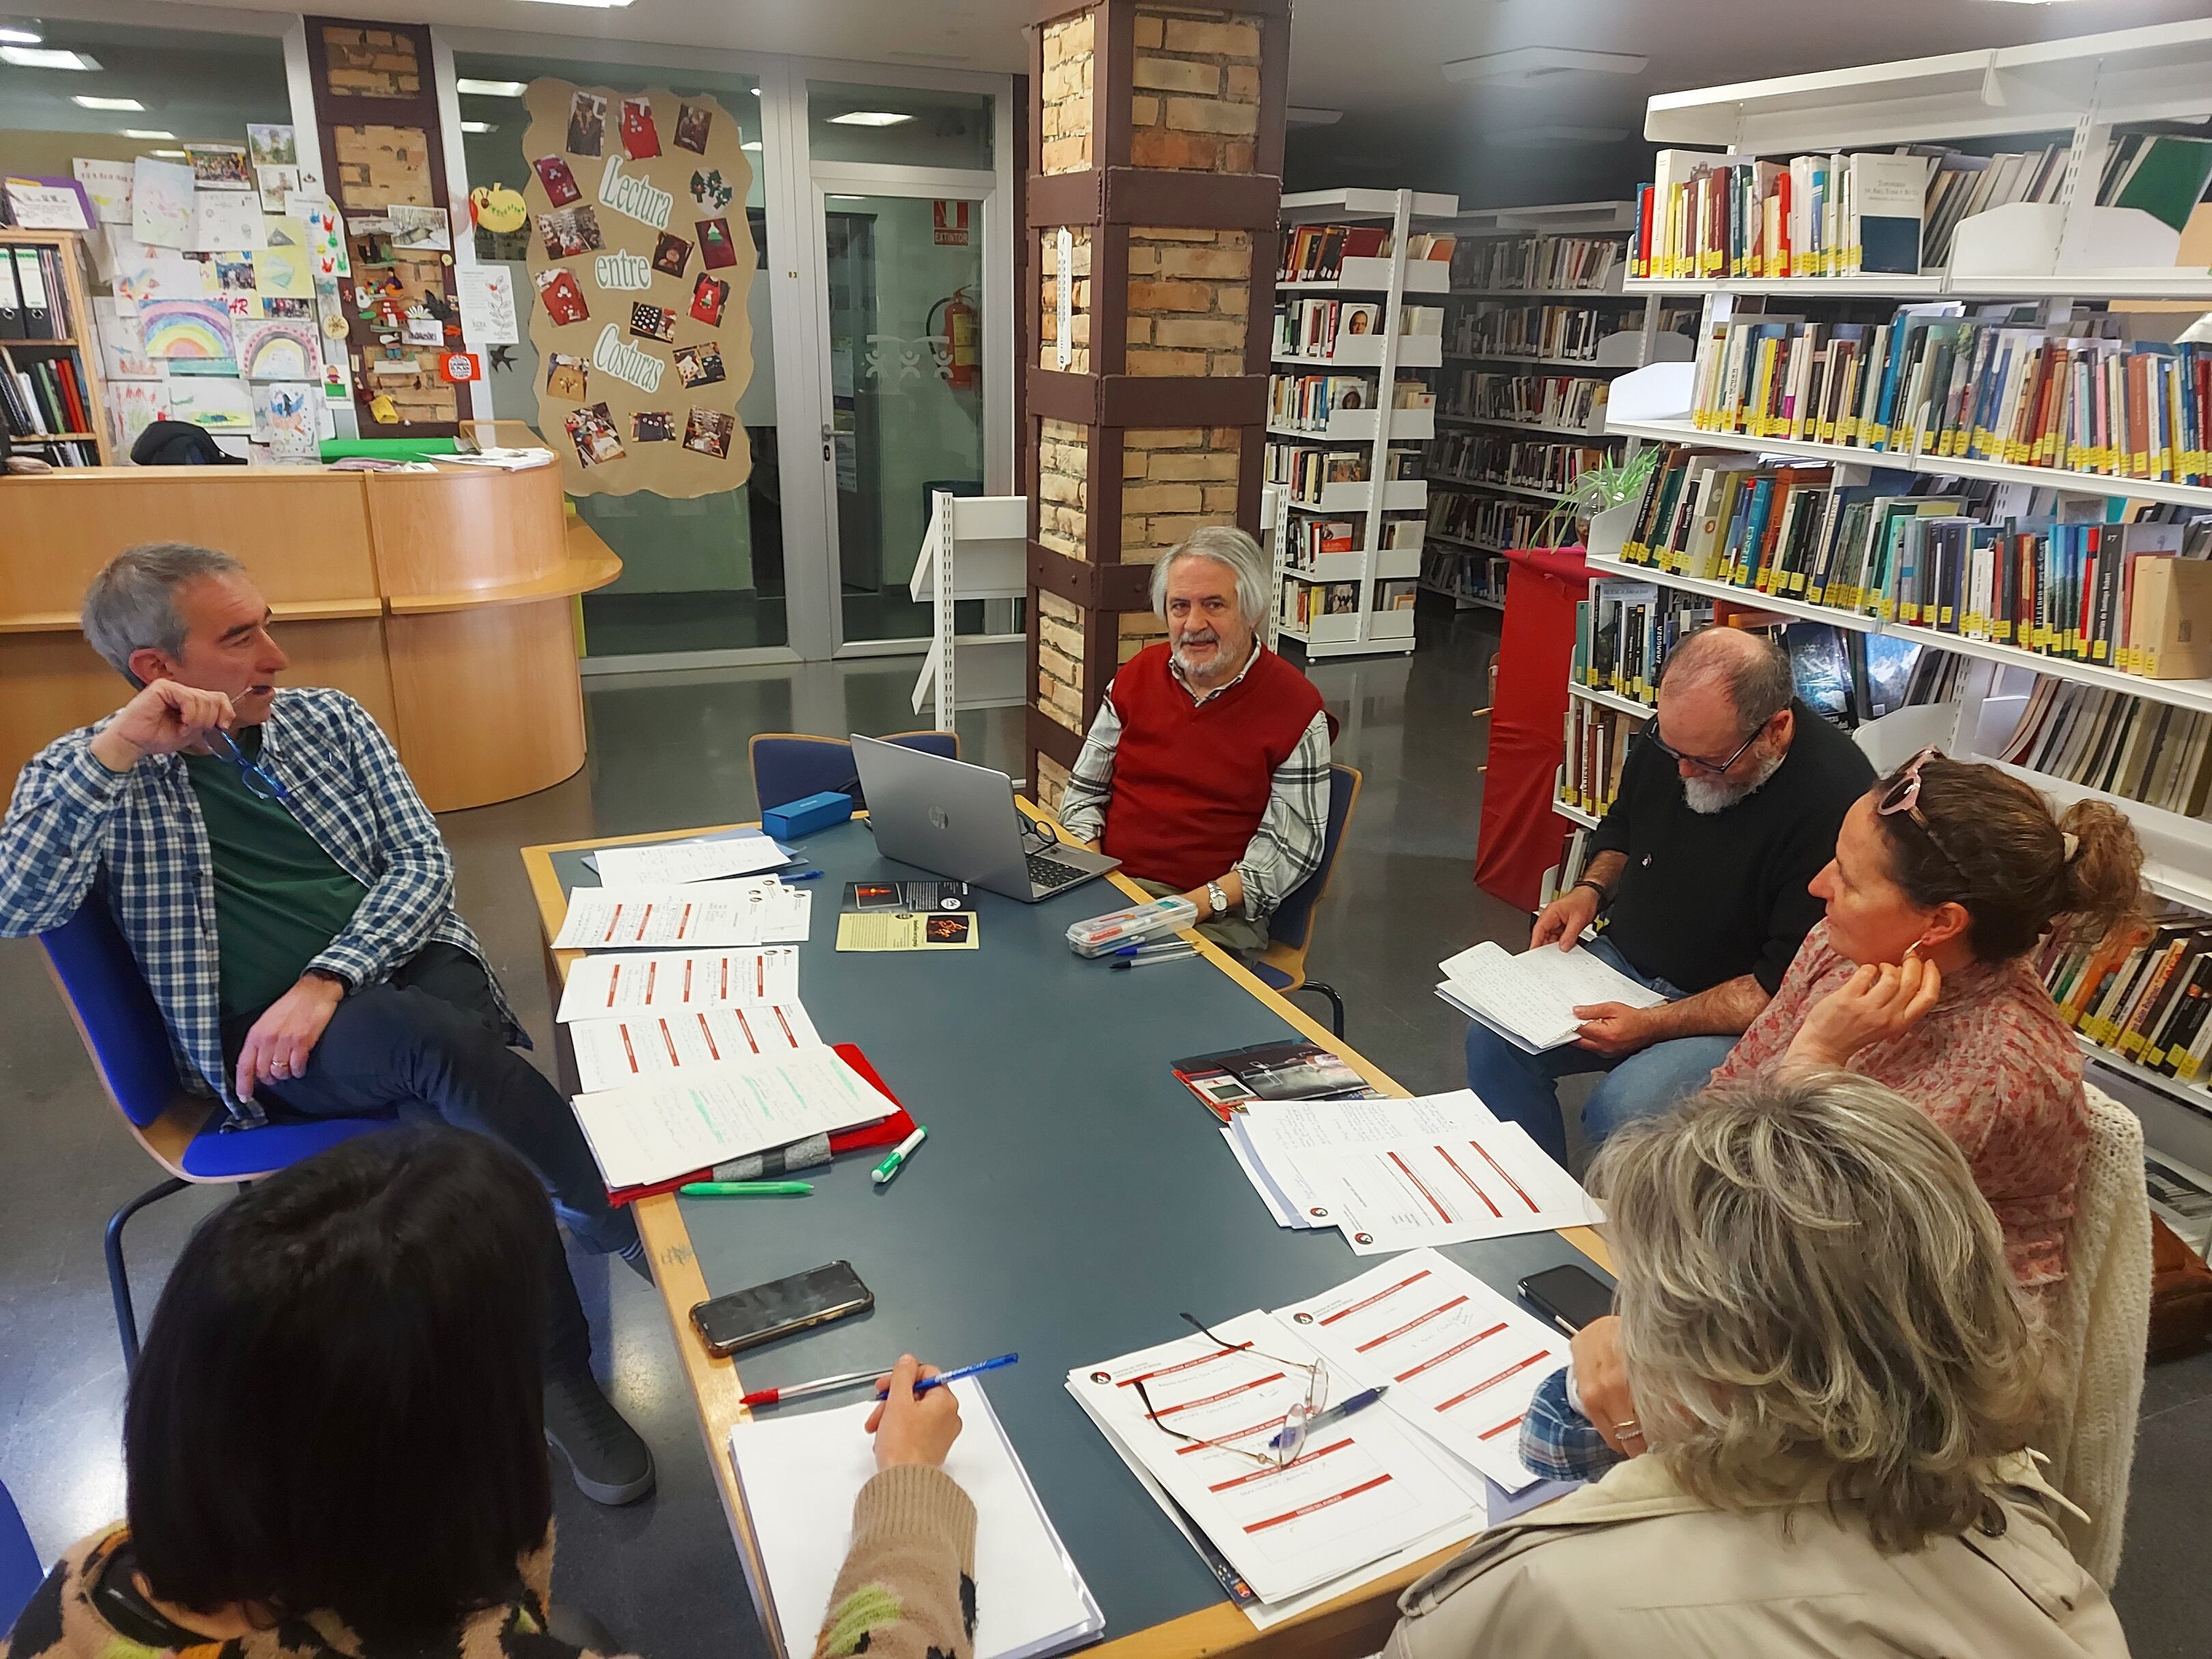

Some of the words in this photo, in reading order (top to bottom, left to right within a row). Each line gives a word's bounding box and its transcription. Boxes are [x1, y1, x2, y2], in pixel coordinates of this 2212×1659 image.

[602, 157, 670, 228] Lectura
[935, 232, 968, 243] EXTINTOR
[597, 251, 650, 288] entre
[596, 326, 663, 391] Costuras
[1740, 525, 1755, 564] UESCA
